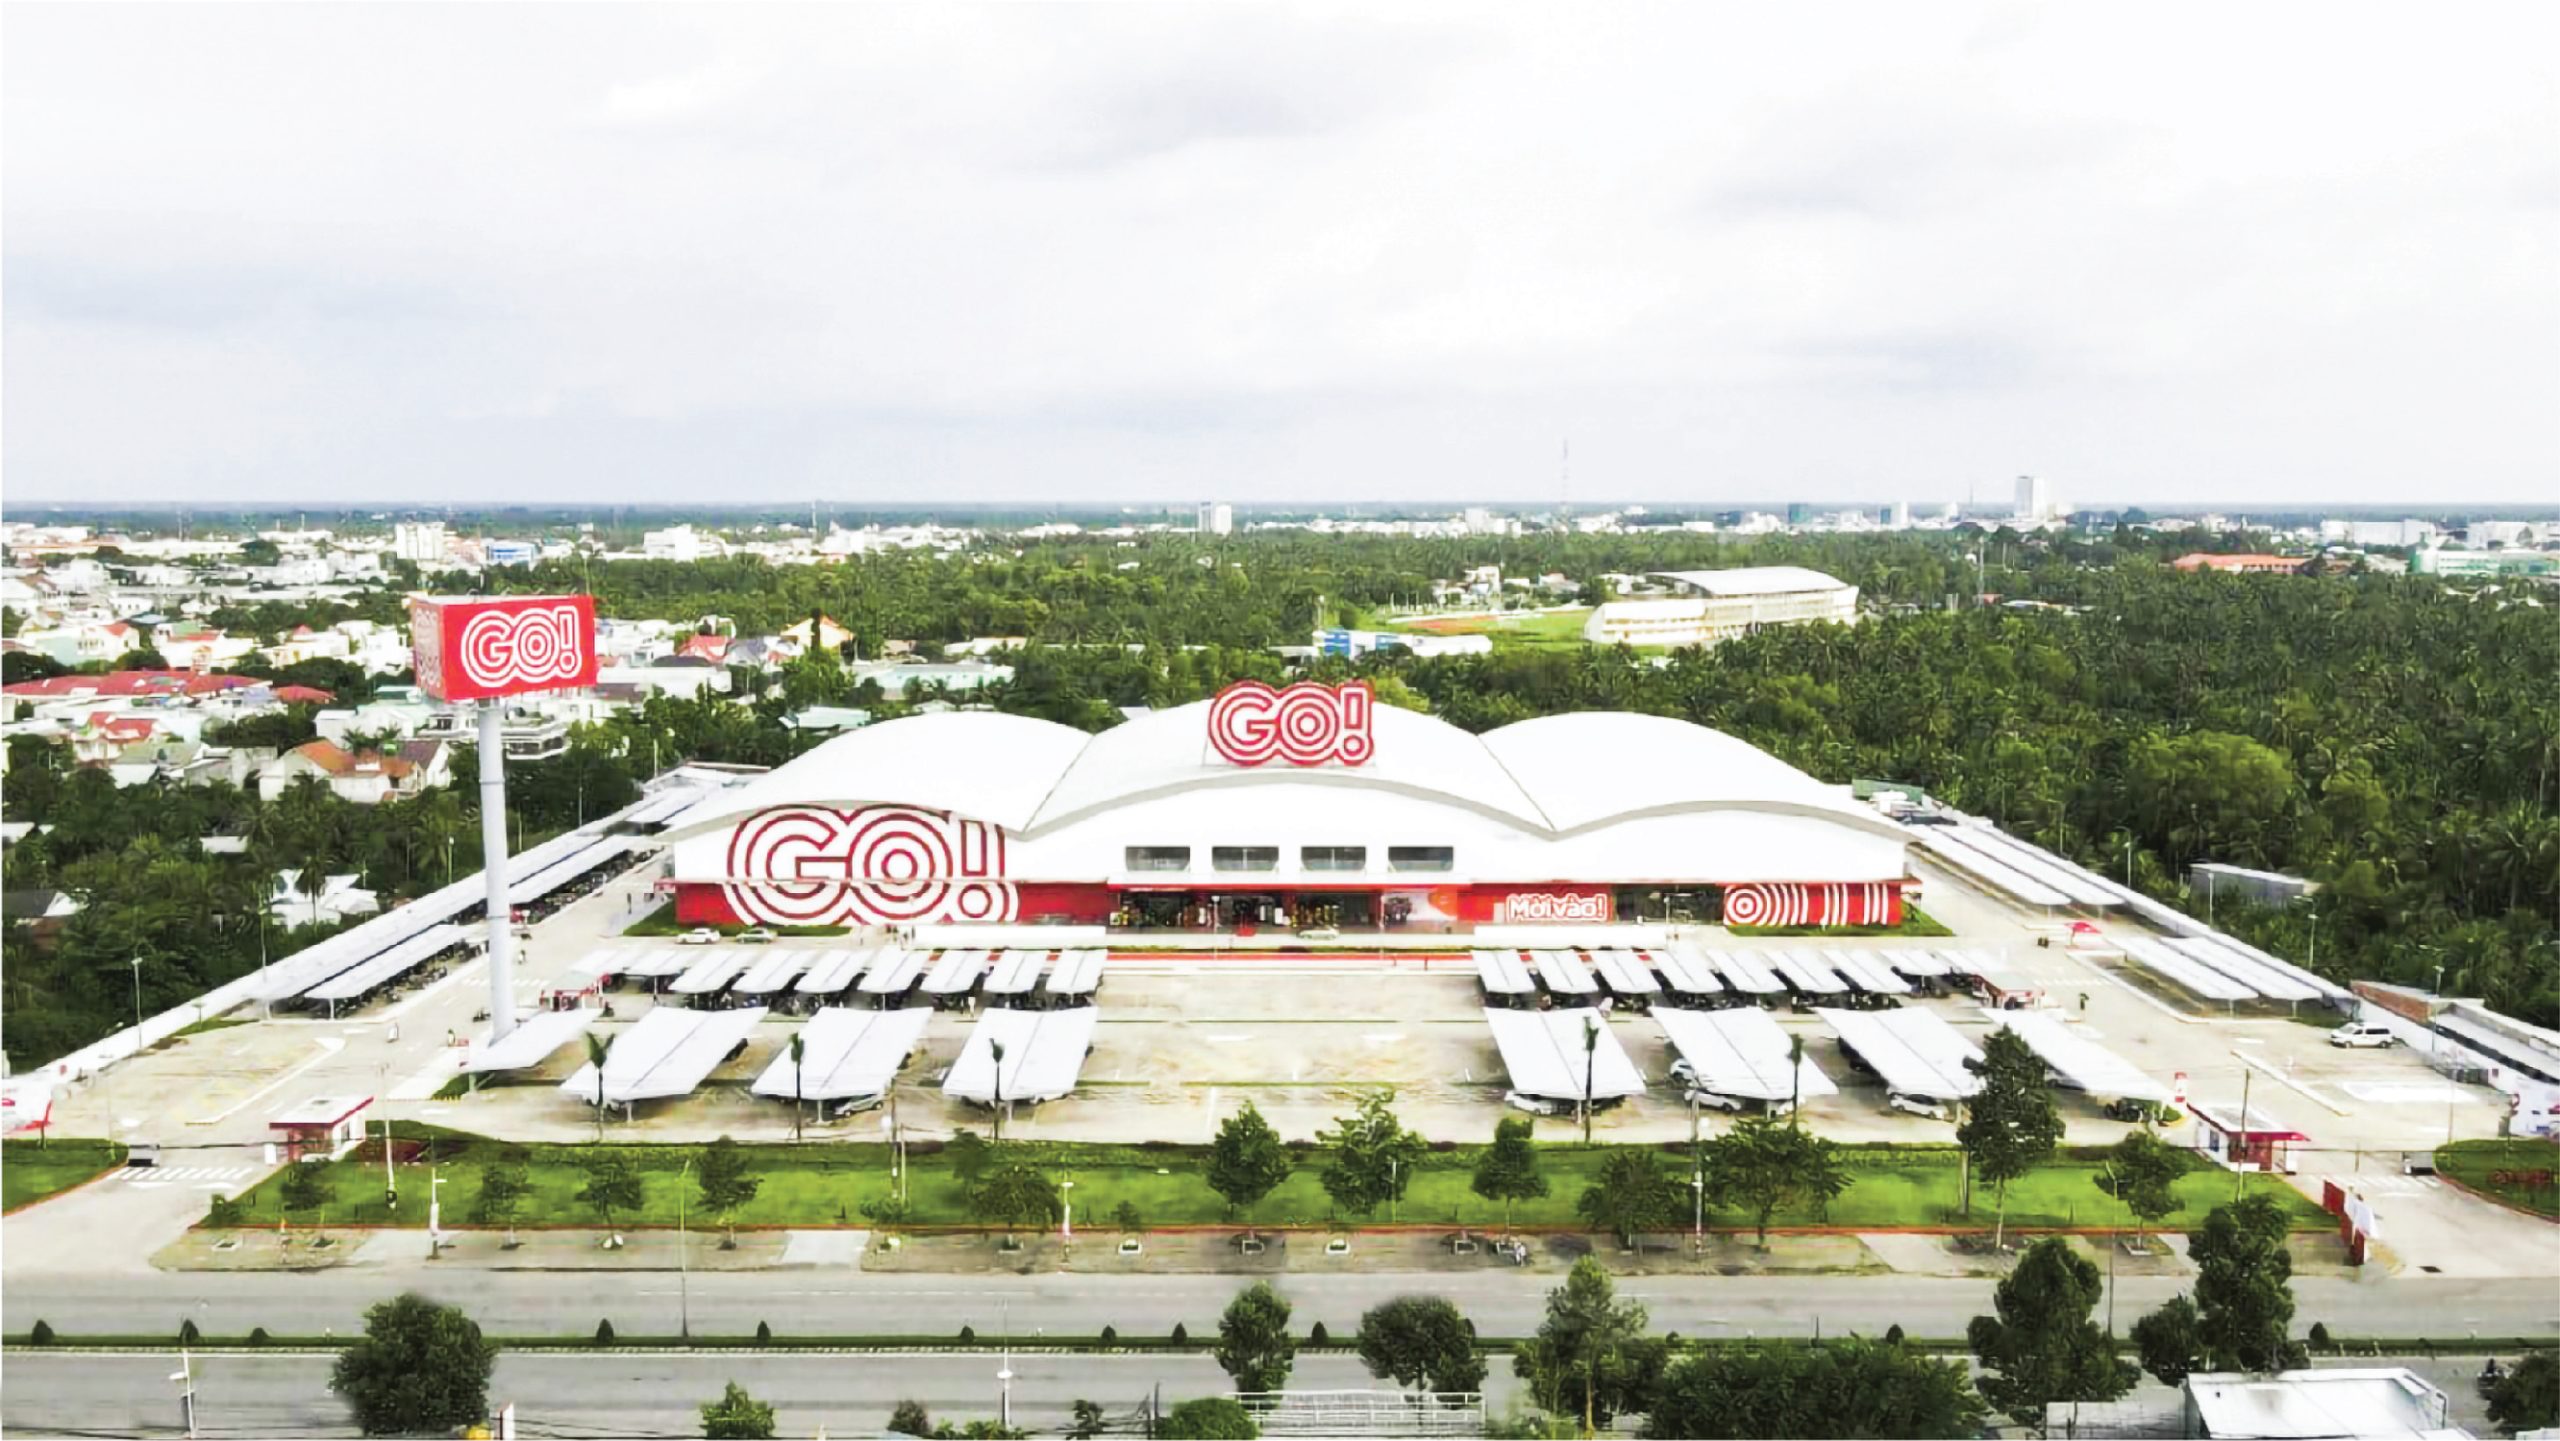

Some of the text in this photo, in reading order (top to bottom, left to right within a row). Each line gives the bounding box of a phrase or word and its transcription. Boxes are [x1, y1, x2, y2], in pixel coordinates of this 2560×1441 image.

[462, 605, 582, 688] GO!
[1208, 681, 1374, 766] GO!
[727, 804, 1014, 923] GO!
